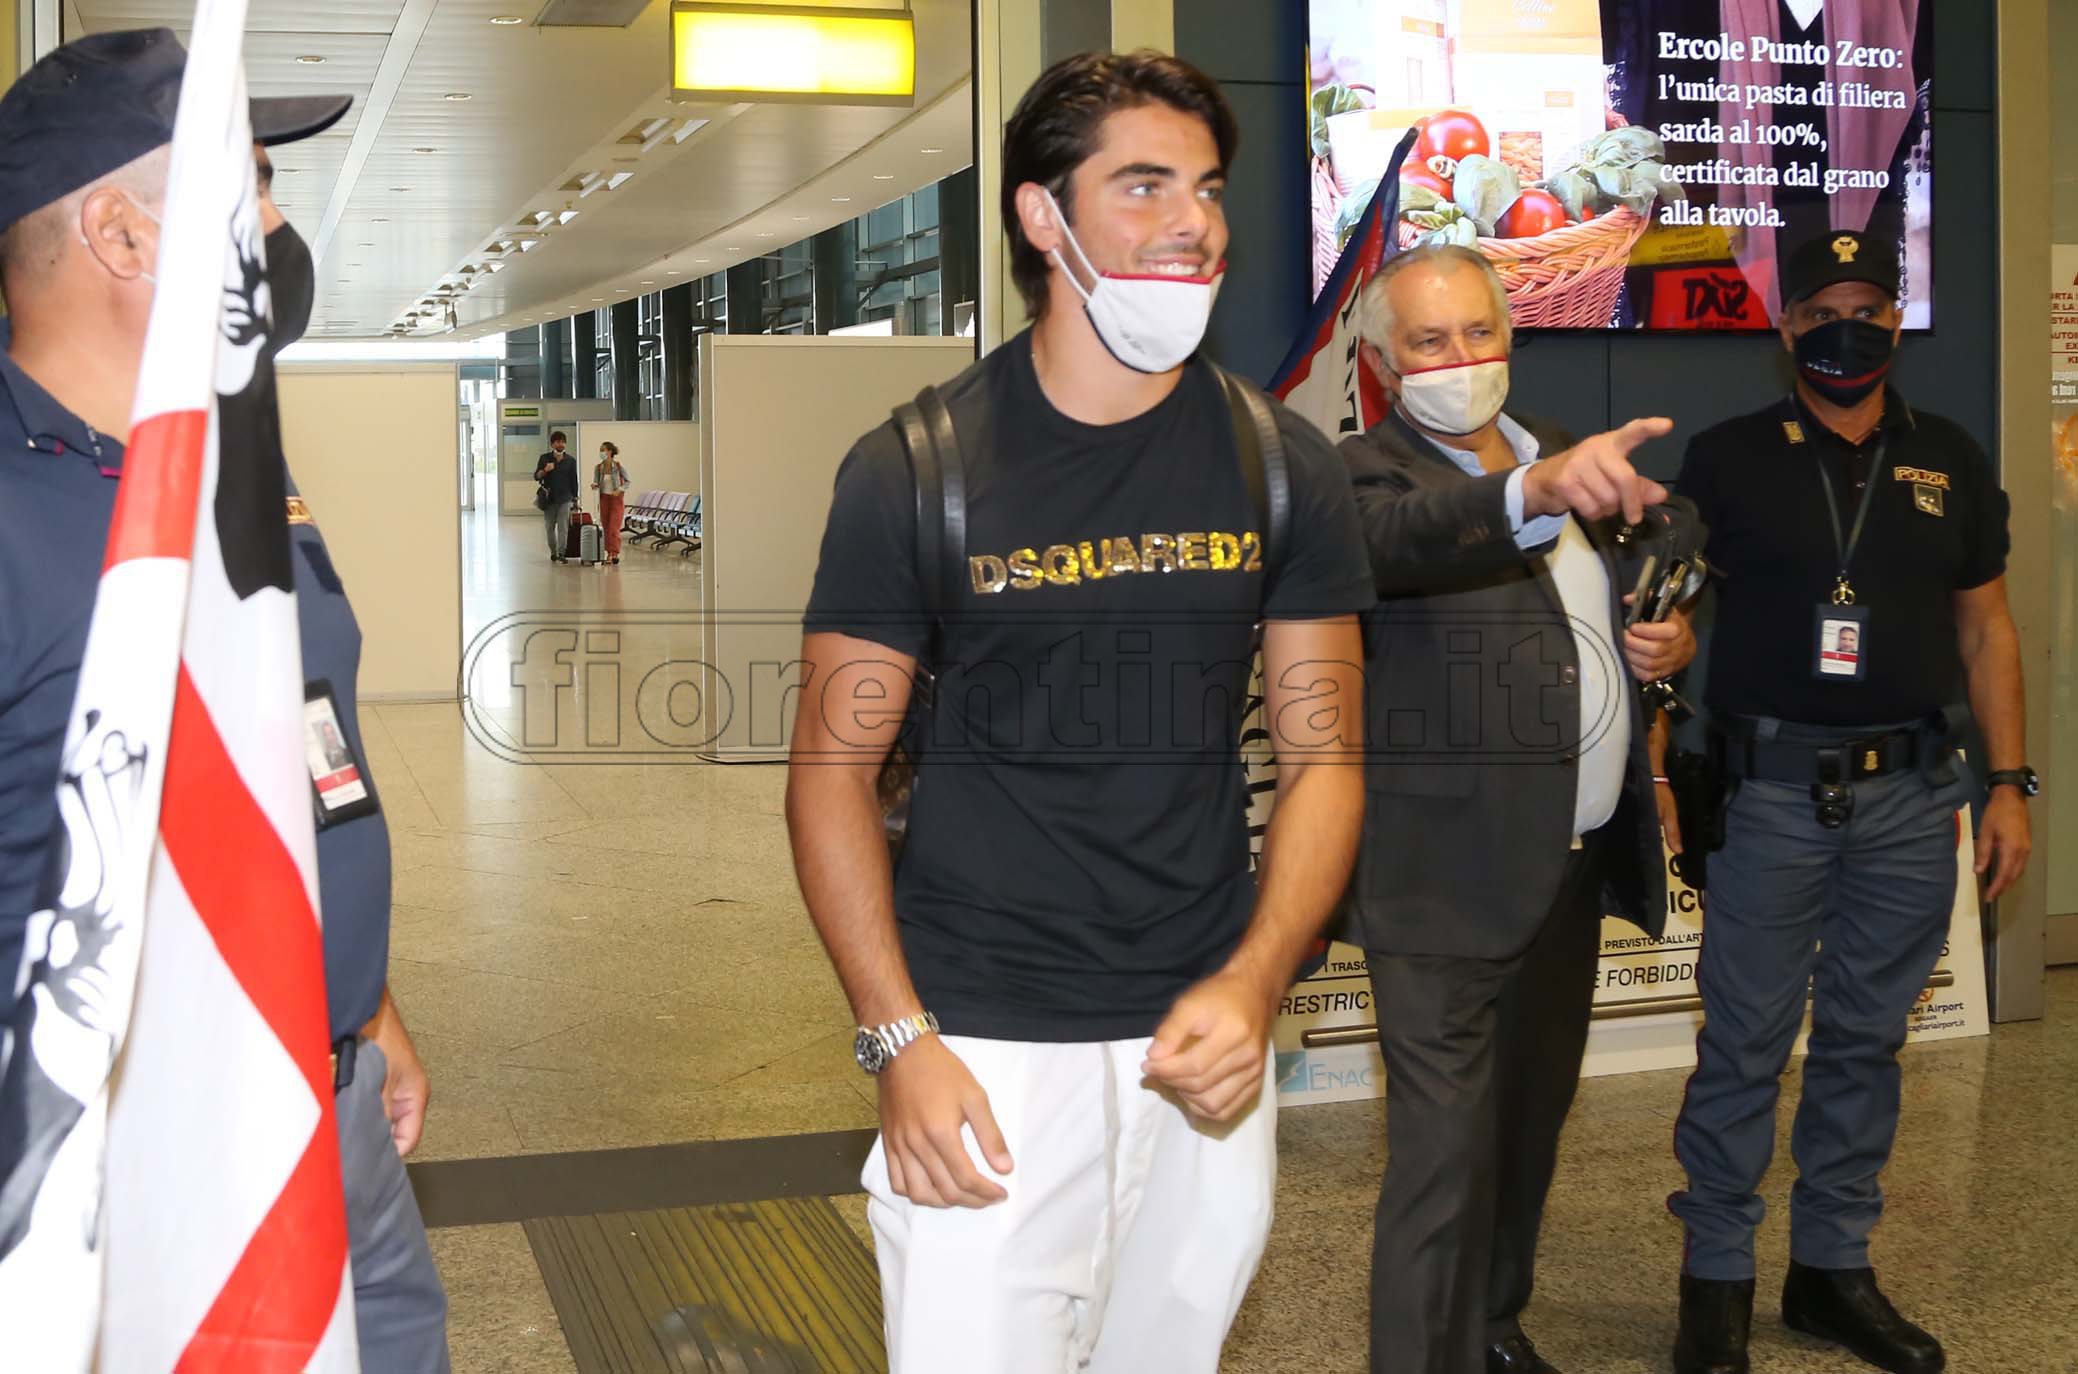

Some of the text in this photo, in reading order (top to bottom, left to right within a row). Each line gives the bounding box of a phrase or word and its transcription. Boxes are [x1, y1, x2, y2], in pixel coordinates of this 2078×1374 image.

[1658, 32, 1904, 68] Ercole Punto Zero:
[1658, 74, 1906, 109] l'unica pasta di filiera
[1659, 118, 1828, 151] sarda al 100%,
[1659, 159, 1889, 194] certificata dal grano
[1660, 200, 1786, 228] alla tavola.
[1898, 470, 1949, 488] POLIZIA
[969, 531, 1262, 594] DSQUARED2
[1605, 935, 1657, 949] PREVISTO
[1278, 991, 1375, 1016] RESTRIC
[1927, 1002, 1964, 1014] Airport
